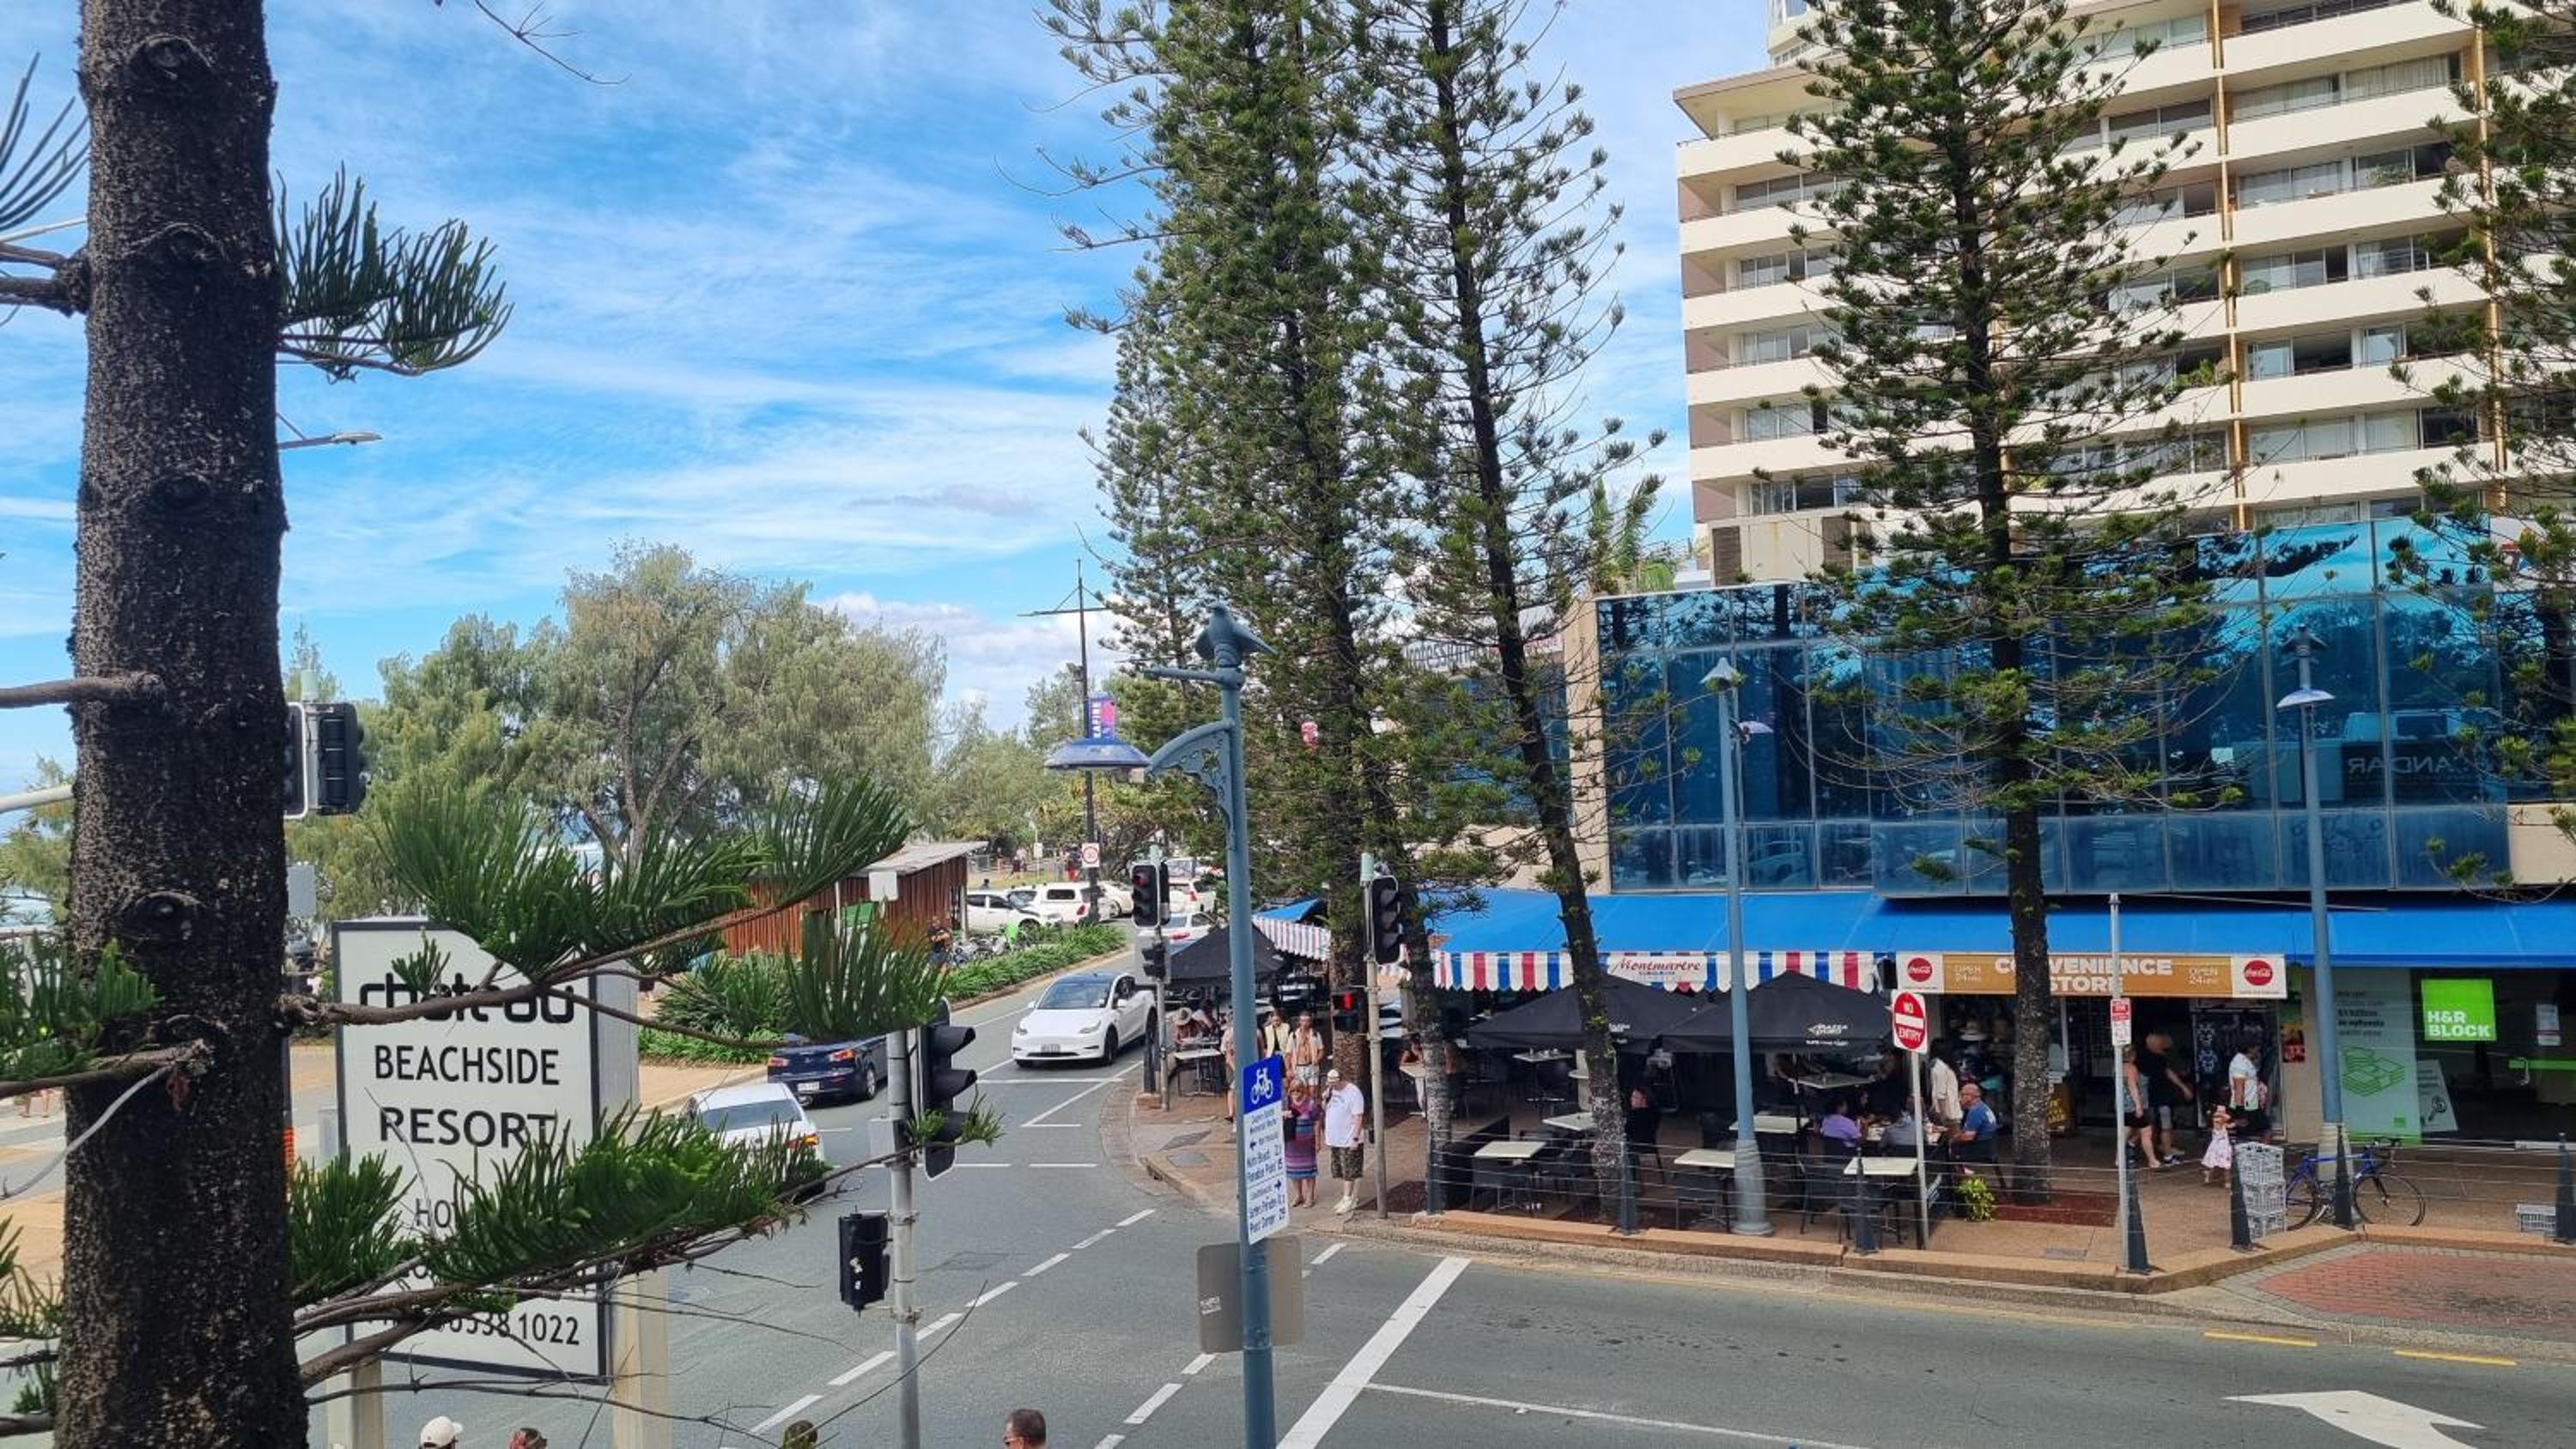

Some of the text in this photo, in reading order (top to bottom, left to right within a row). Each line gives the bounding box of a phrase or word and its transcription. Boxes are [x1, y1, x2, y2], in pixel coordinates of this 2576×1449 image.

[1995, 957, 2172, 975] CVENIENCE
[1903, 1001, 1914, 1015] NO
[2427, 1010, 2466, 1024] H&R
[1899, 1027, 1923, 1043] ENTRY
[2429, 1024, 2490, 1038] BLOCK
[374, 1045, 560, 1086] BEACHSIDE
[380, 1106, 557, 1149] RESORT
[518, 1313, 580, 1346] 1022
